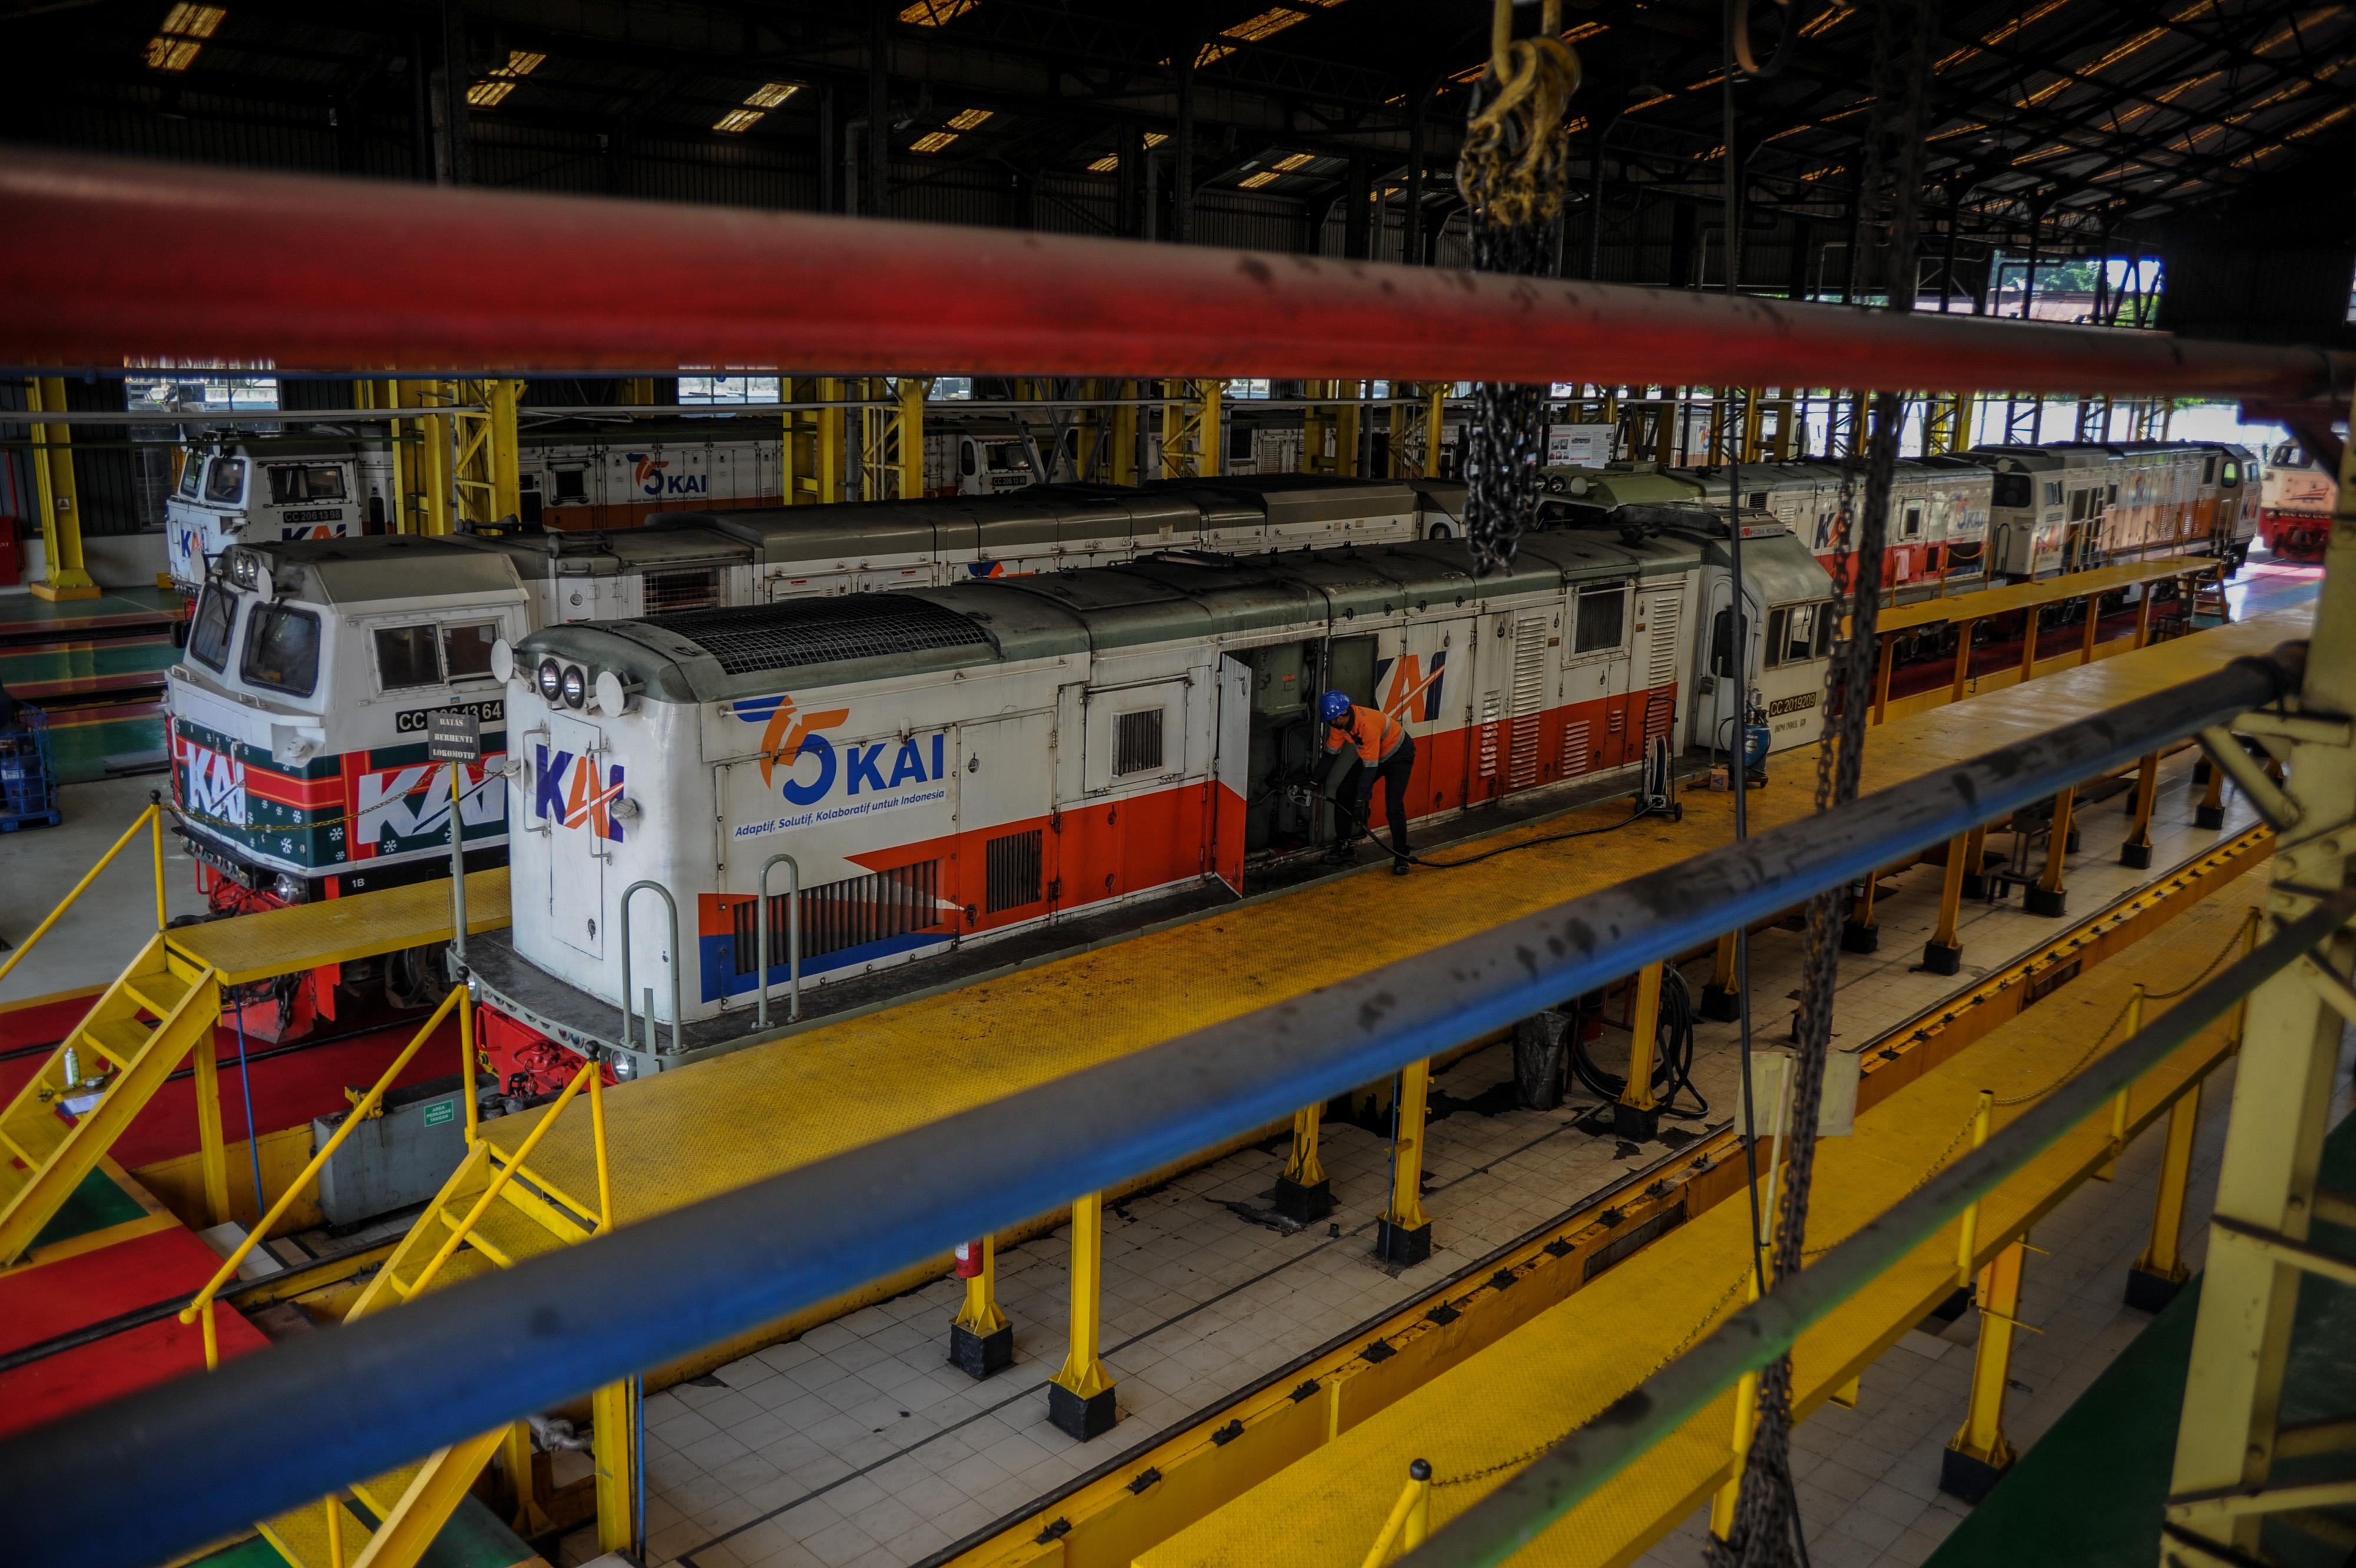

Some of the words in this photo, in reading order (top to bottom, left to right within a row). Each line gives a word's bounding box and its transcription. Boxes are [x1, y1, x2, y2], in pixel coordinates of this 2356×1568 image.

[668, 475, 706, 493] KAI
[284, 512, 300, 522] CC
[301, 511, 317, 521] 206
[319, 511, 329, 520] 13
[330, 510, 340, 519] 98
[1771, 700, 1783, 715] CC
[1784, 693, 1815, 713] 2019209
[399, 712, 425, 730] CC
[482, 702, 502, 720] 64
[439, 718, 464, 727] BATAS
[434, 733, 473, 744] BERHENTI
[432, 749, 476, 760] LOKOMOTIF
[847, 733, 944, 795] KAI
[186, 742, 246, 831] KAI
[535, 743, 624, 843] KAI
[357, 753, 507, 845] KAI
[735, 820, 776, 837] Adaptif,
[779, 813, 813, 828] Solutif,
[816, 802, 871, 822] Kolaboratif
[872, 798, 899, 811] untuk
[901, 789, 945, 805] Indonesia
[352, 878, 365, 888] 1B
